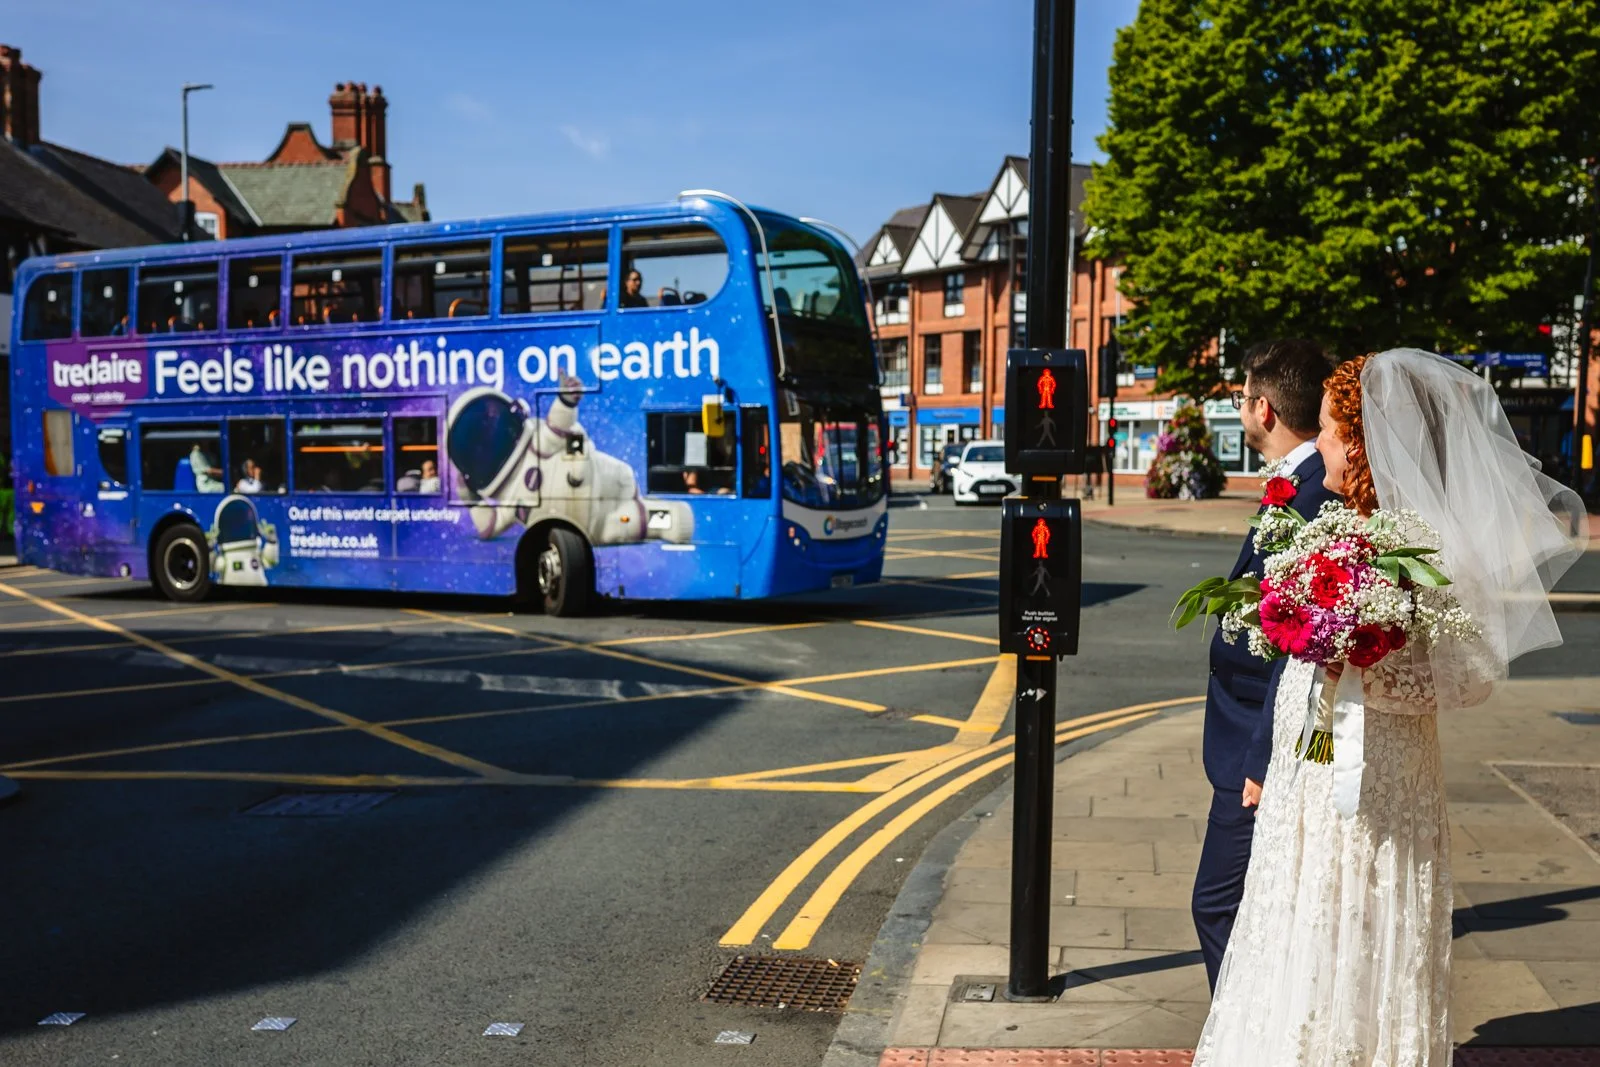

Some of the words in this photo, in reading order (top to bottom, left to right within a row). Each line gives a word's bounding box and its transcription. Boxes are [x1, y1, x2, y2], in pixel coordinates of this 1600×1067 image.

[53, 352, 142, 388] tredaire
[155, 350, 254, 395] Feels
[263, 344, 331, 391] like
[342, 336, 505, 391] nothing
[517, 344, 577, 384] on
[590, 326, 720, 380] earth
[288, 506, 309, 521] Out
[310, 506, 322, 521] of
[322, 506, 342, 521] this
[343, 506, 374, 521] world
[375, 507, 410, 523] carpet
[411, 507, 460, 524] underlay
[290, 532, 378, 549] tredaire.co.uk
